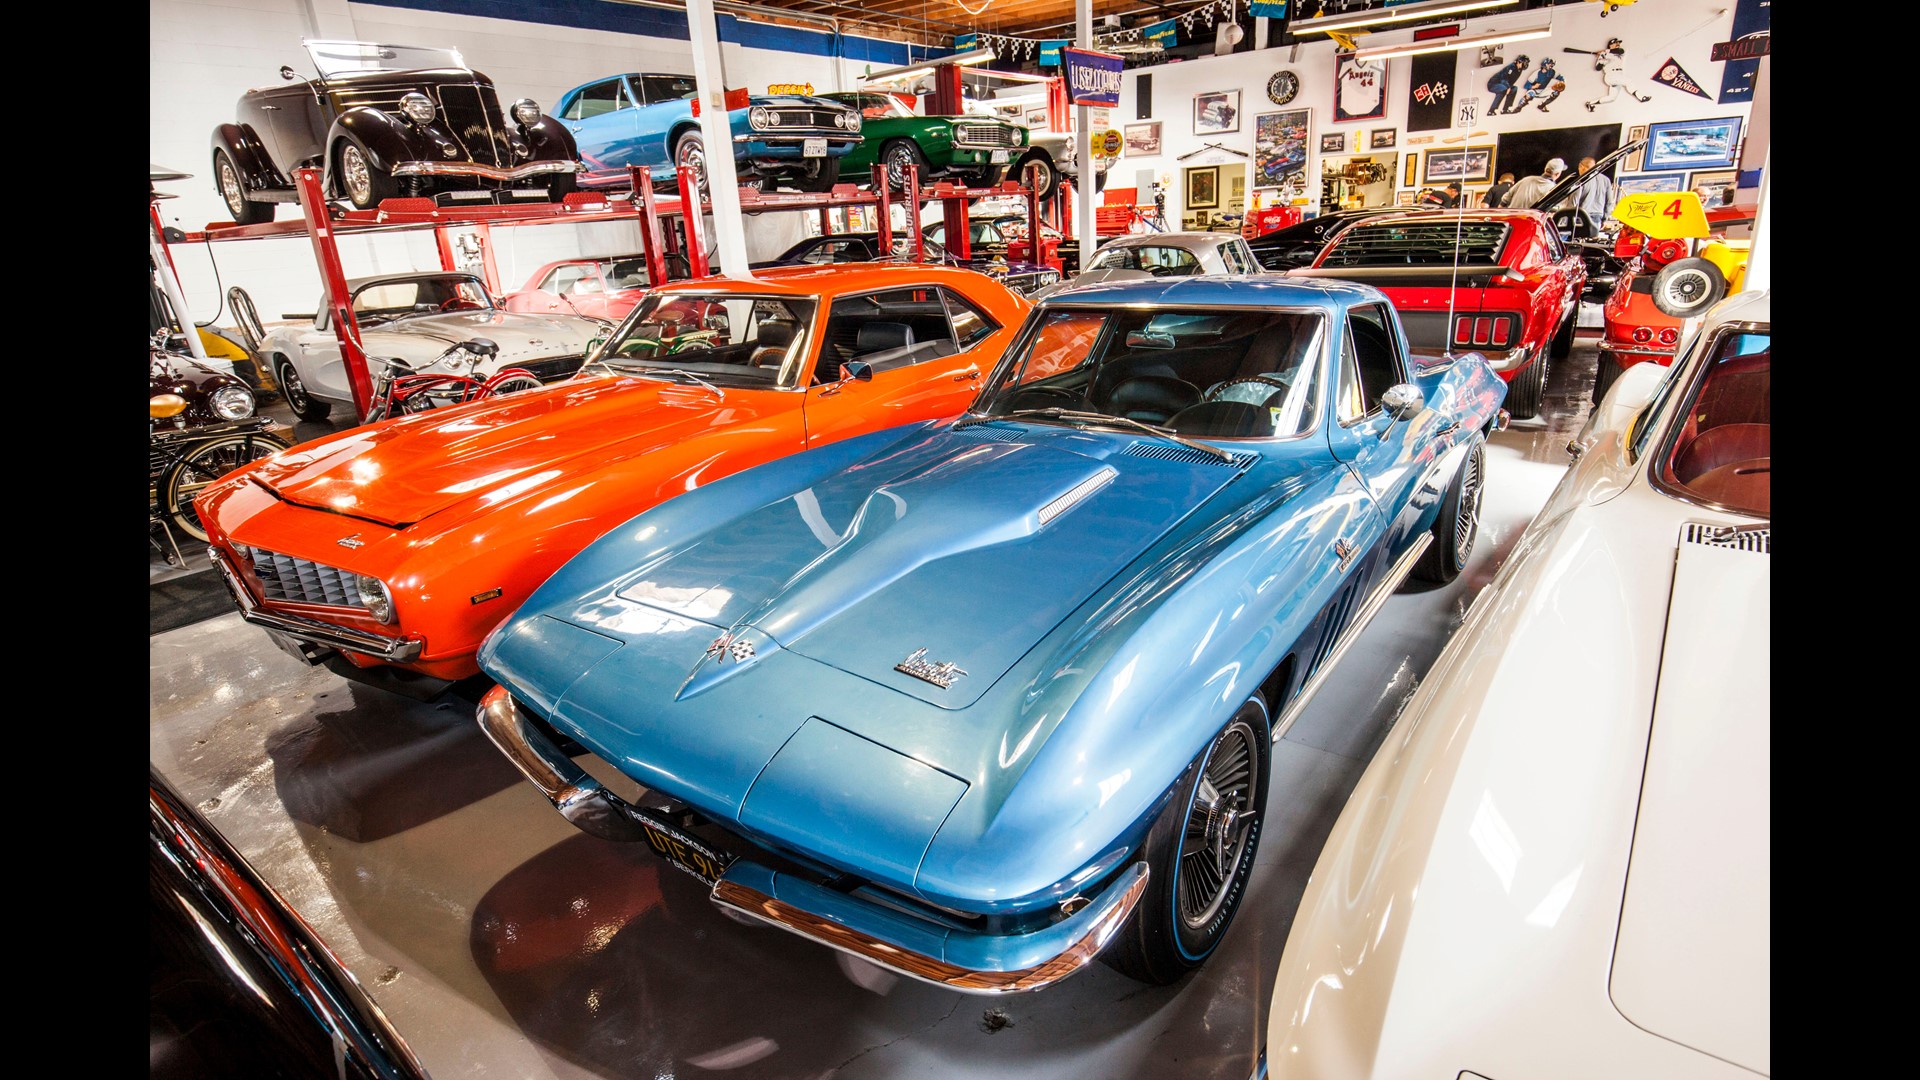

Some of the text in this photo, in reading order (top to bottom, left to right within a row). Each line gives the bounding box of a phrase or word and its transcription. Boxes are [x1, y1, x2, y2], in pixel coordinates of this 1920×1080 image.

[1721, 41, 1757, 58] SMALL
[1348, 71, 1374, 80] Angels
[1360, 78, 1373, 87] 44
[1671, 77, 1700, 94] YANKEES
[1269, 89, 1296, 105] SERVICE
[1663, 199, 1683, 220] 4
[643, 825, 695, 870] UTE
[670, 829, 718, 862] JACKSON
[1240, 819, 1259, 877] SPEEDWAY
[1226, 882, 1240, 907] BLUE
